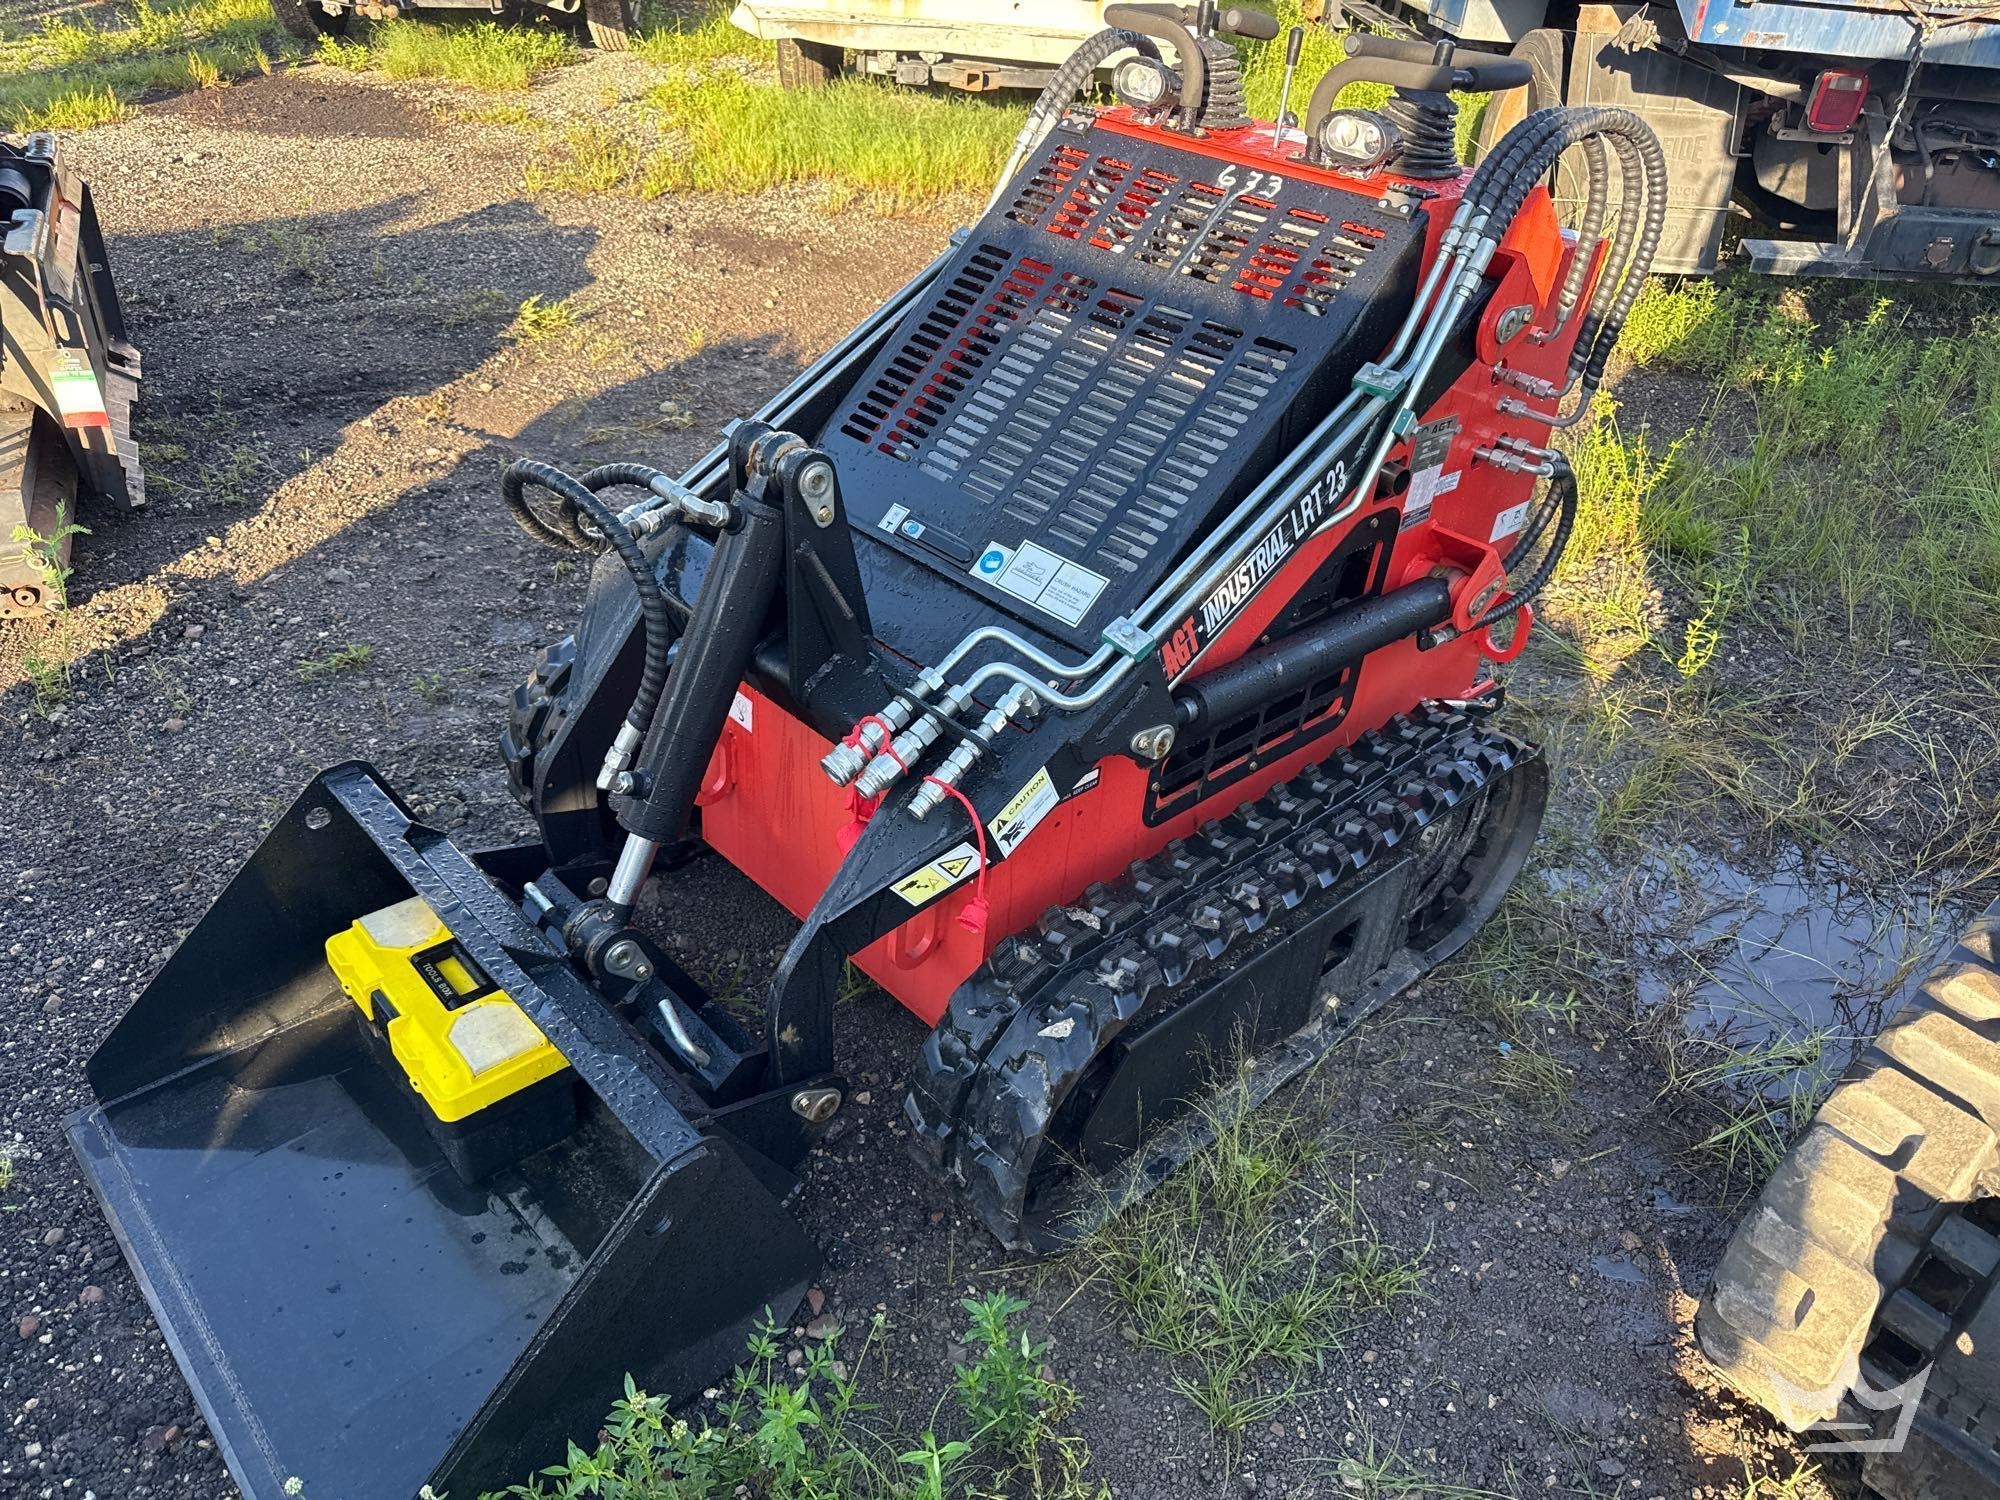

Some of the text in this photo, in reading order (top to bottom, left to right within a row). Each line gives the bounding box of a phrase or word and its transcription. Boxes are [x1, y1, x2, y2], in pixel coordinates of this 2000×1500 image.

[1432, 420, 1453, 434] AGT
[1291, 480, 1323, 540] LRT
[1326, 460, 1348, 504] 23
[1008, 776, 1045, 816] CAUTION
[423, 963, 454, 998] TOOLS BOX
